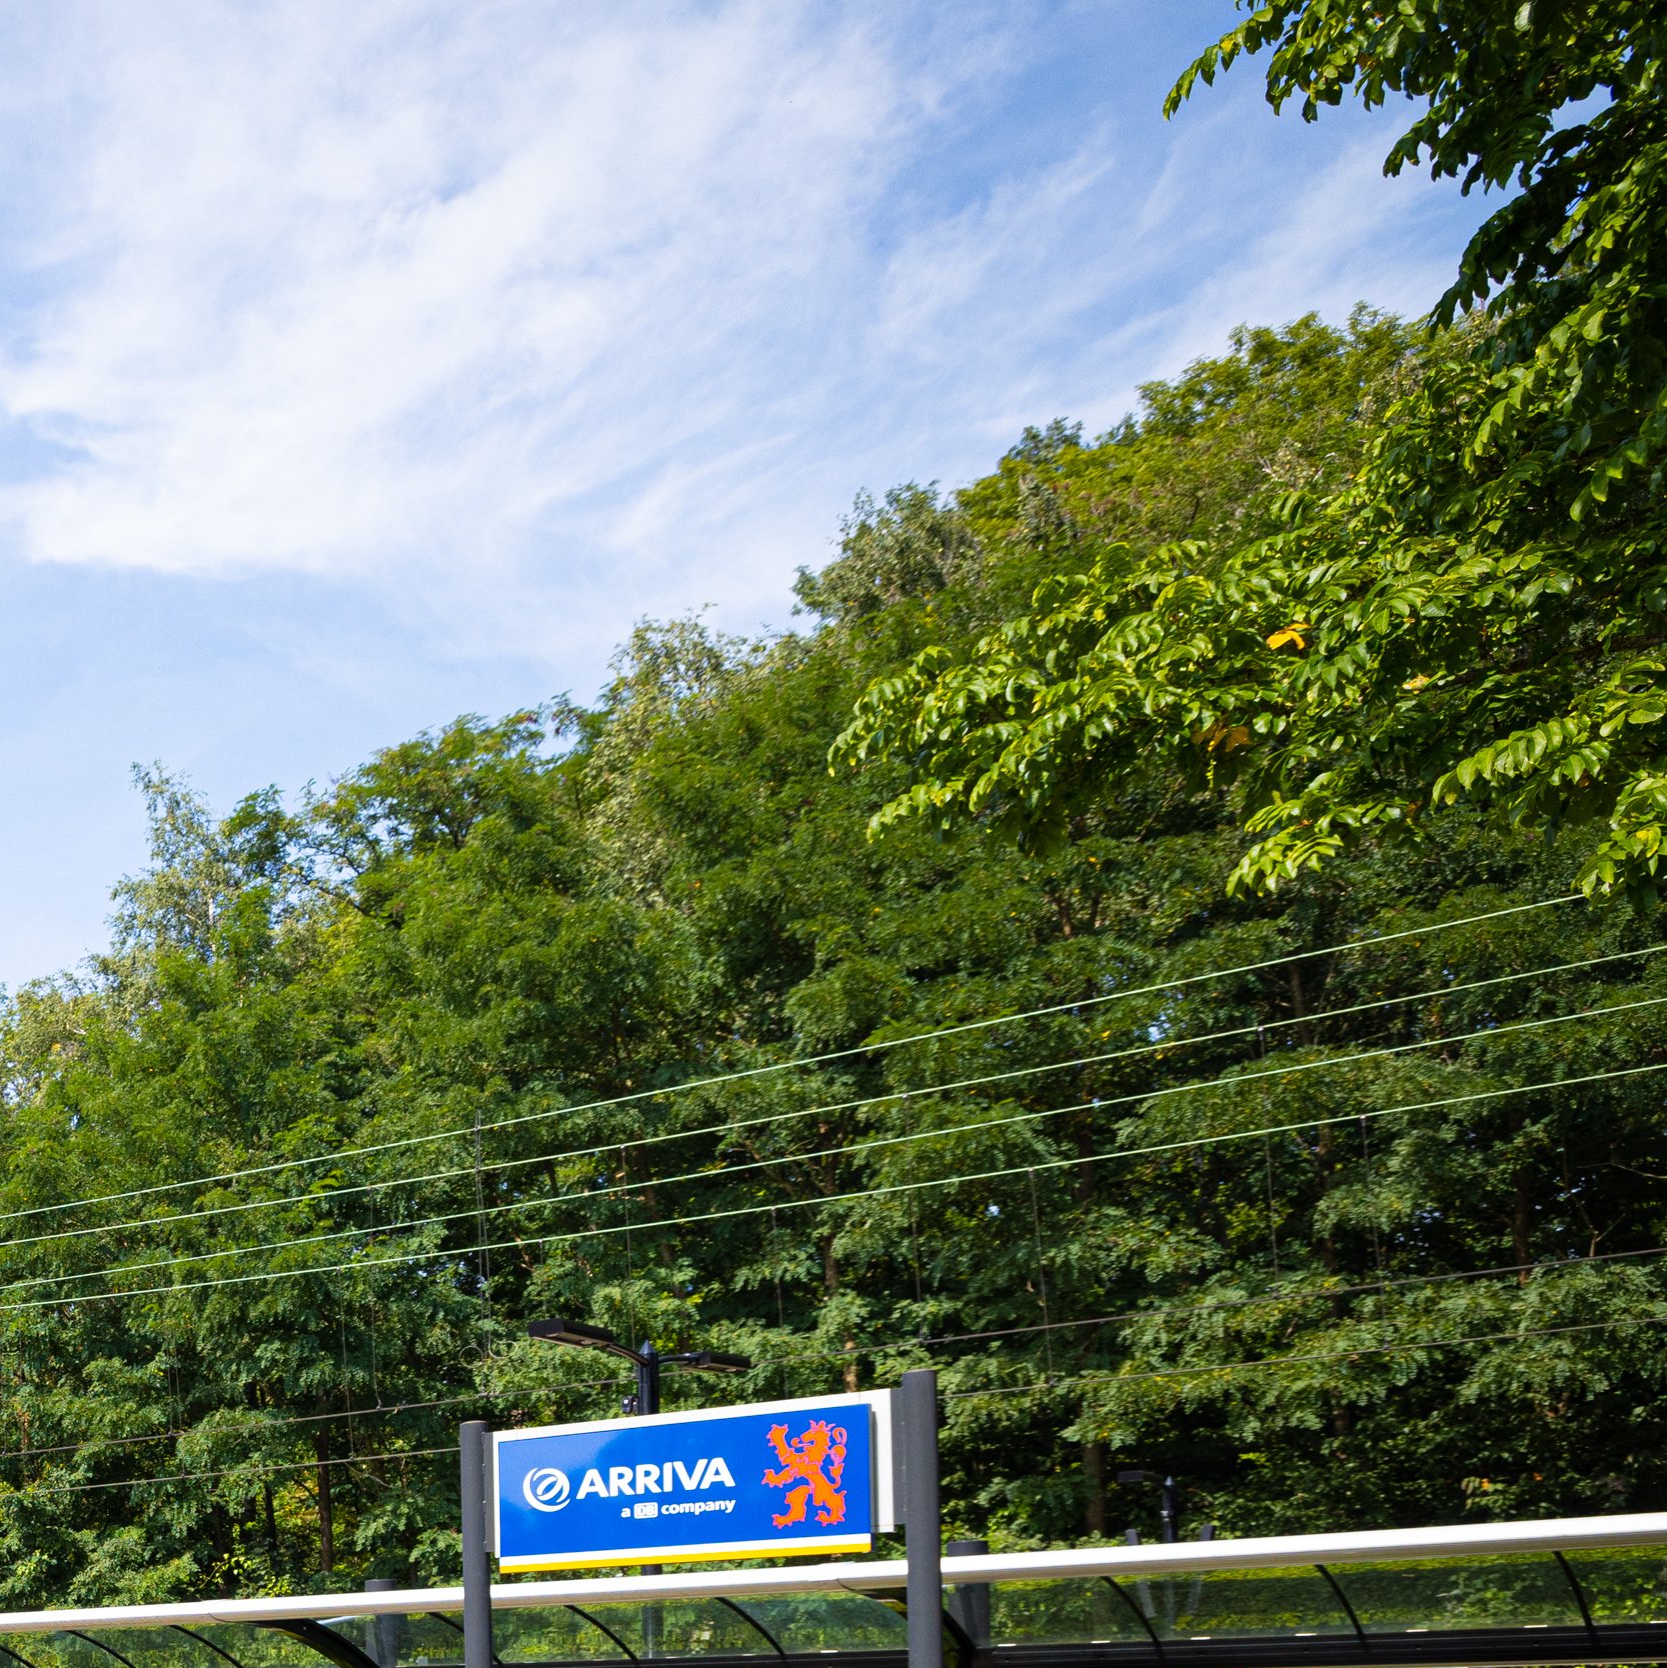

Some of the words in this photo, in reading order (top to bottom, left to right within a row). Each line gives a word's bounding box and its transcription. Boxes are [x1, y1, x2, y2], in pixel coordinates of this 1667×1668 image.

[575, 1457, 736, 1500] ARRIVA
[620, 1507, 631, 1518] a
[661, 1499, 736, 1516] company
